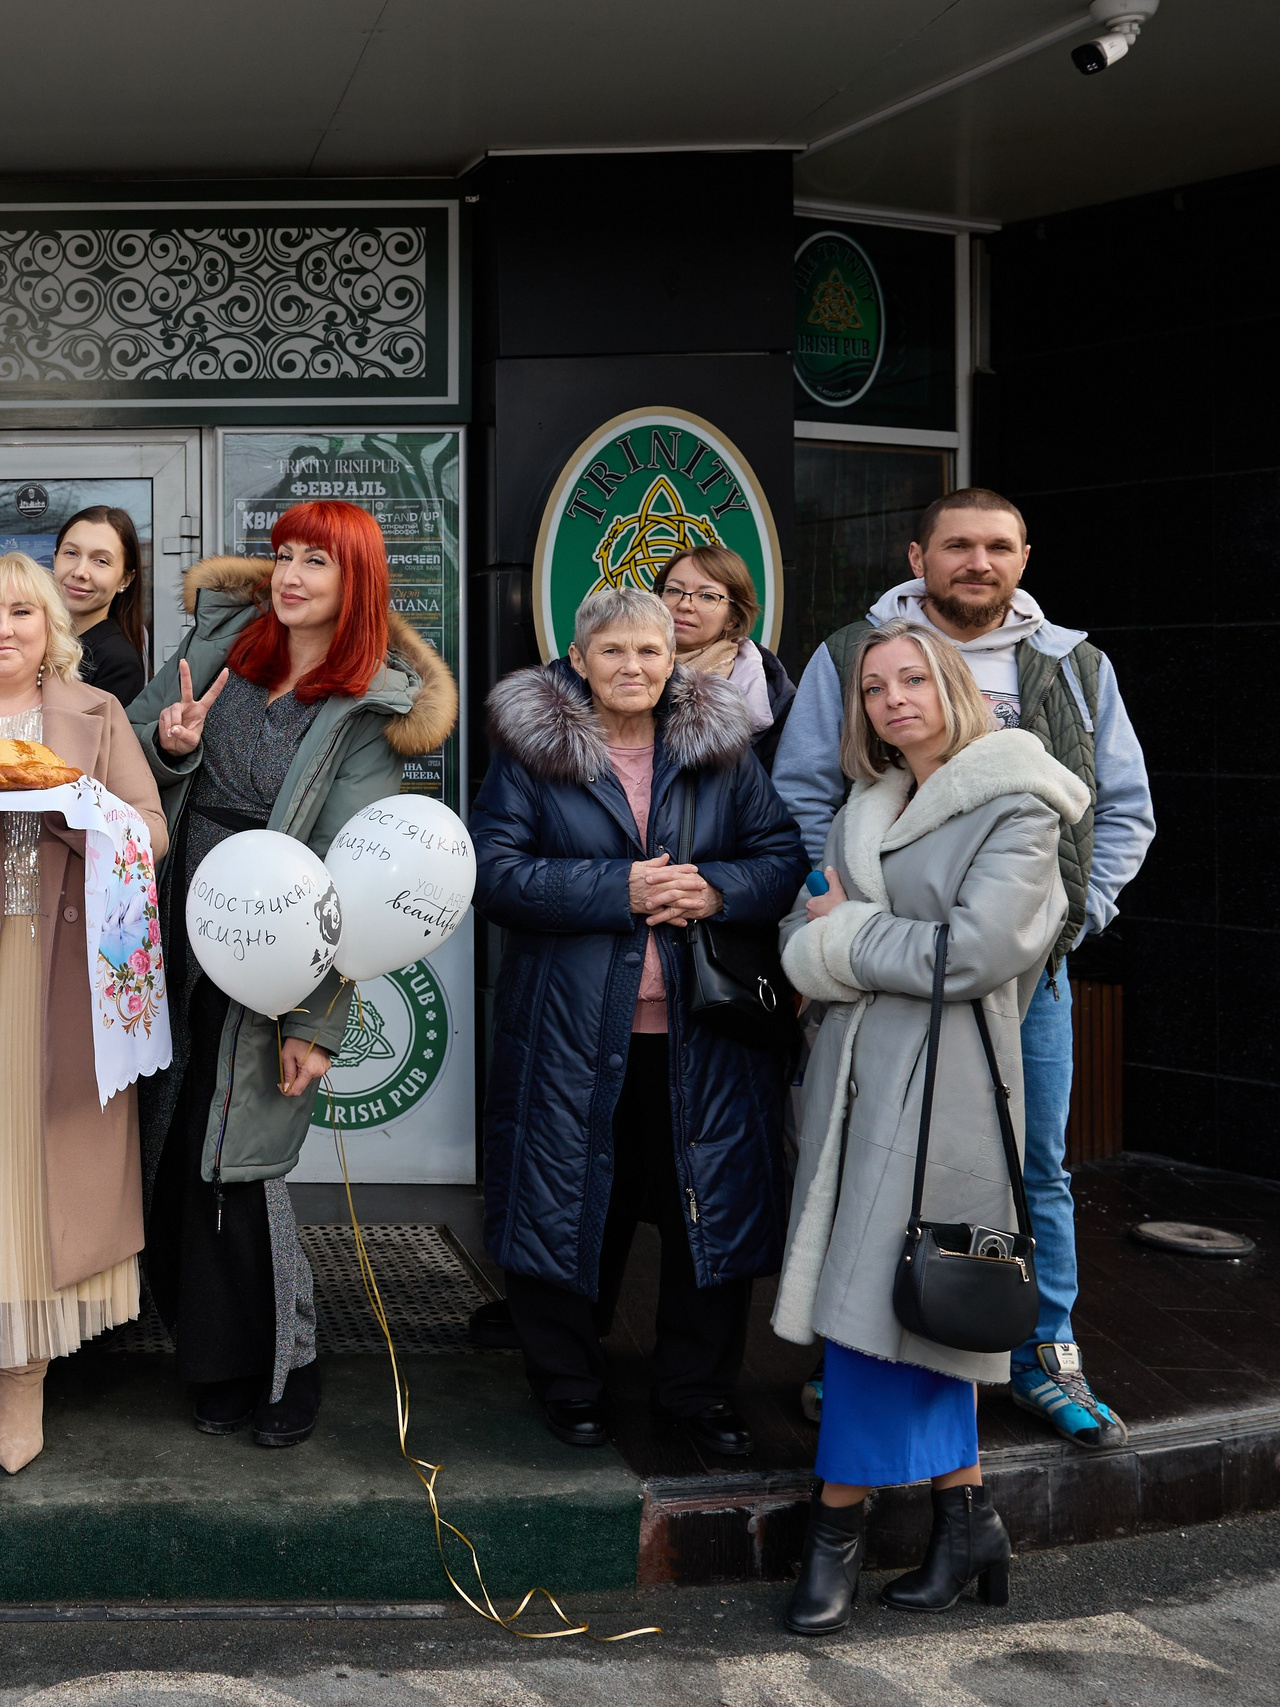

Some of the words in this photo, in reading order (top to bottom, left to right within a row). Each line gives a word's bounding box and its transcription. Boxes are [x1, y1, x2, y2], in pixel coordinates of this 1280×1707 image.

[798, 334, 838, 356] IRISH
[842, 336, 871, 357] PUB
[277, 459, 332, 474] TRINITY
[335, 459, 370, 474] IRISH
[372, 459, 400, 474] PUB
[566, 430, 750, 524] TRINITY
[290, 481, 386, 496] ФЕВРАЛЬ
[242, 511, 282, 530] КВИ
[416, 879, 443, 900] YOU
[446, 892, 466, 909] ARE
[400, 962, 436, 1006] PUB
[324, 1098, 387, 1124] IRISH
[388, 1067, 428, 1108] PUB
